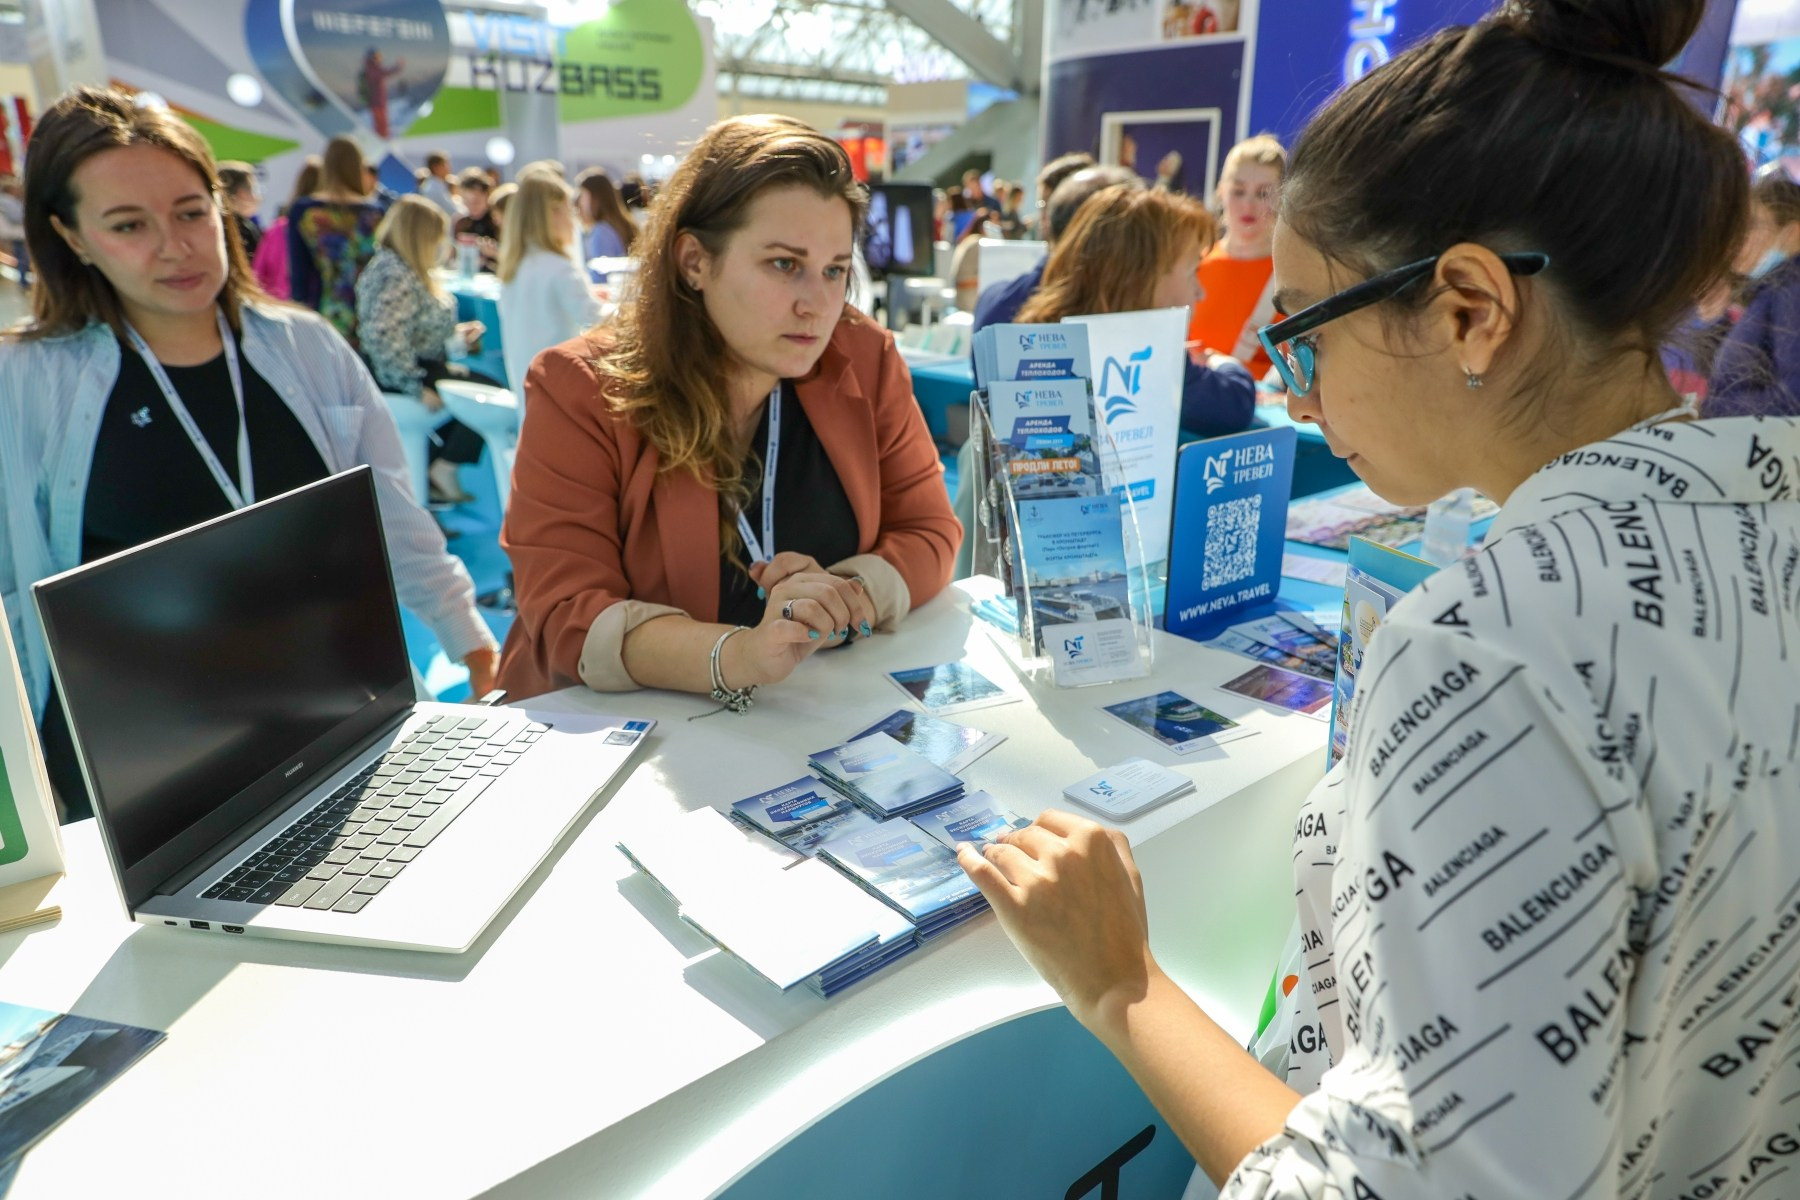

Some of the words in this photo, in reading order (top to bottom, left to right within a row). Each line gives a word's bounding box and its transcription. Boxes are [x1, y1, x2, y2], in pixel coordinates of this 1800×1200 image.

[464, 10, 577, 57] VISIT
[470, 54, 662, 101] KUZBASS
[1038, 334, 1066, 342] НЕВА
[1034, 390, 1062, 398] НЕВА
[1012, 461, 1050, 472] ПРОДЛИ
[1052, 459, 1079, 469] ЛЕТО!
[1233, 463, 1273, 485] ТРЕВЕЛ
[1234, 443, 1274, 467] НЕВА
[1179, 582, 1271, 622] WWW.NEVA.TRAVEL
[1369, 660, 1482, 779] BALENCIAGA
[1412, 729, 1490, 795] BALENCIAGA
[1422, 826, 1508, 897] BALENCIAGA
[1480, 843, 1615, 954] BALENCIAGA
